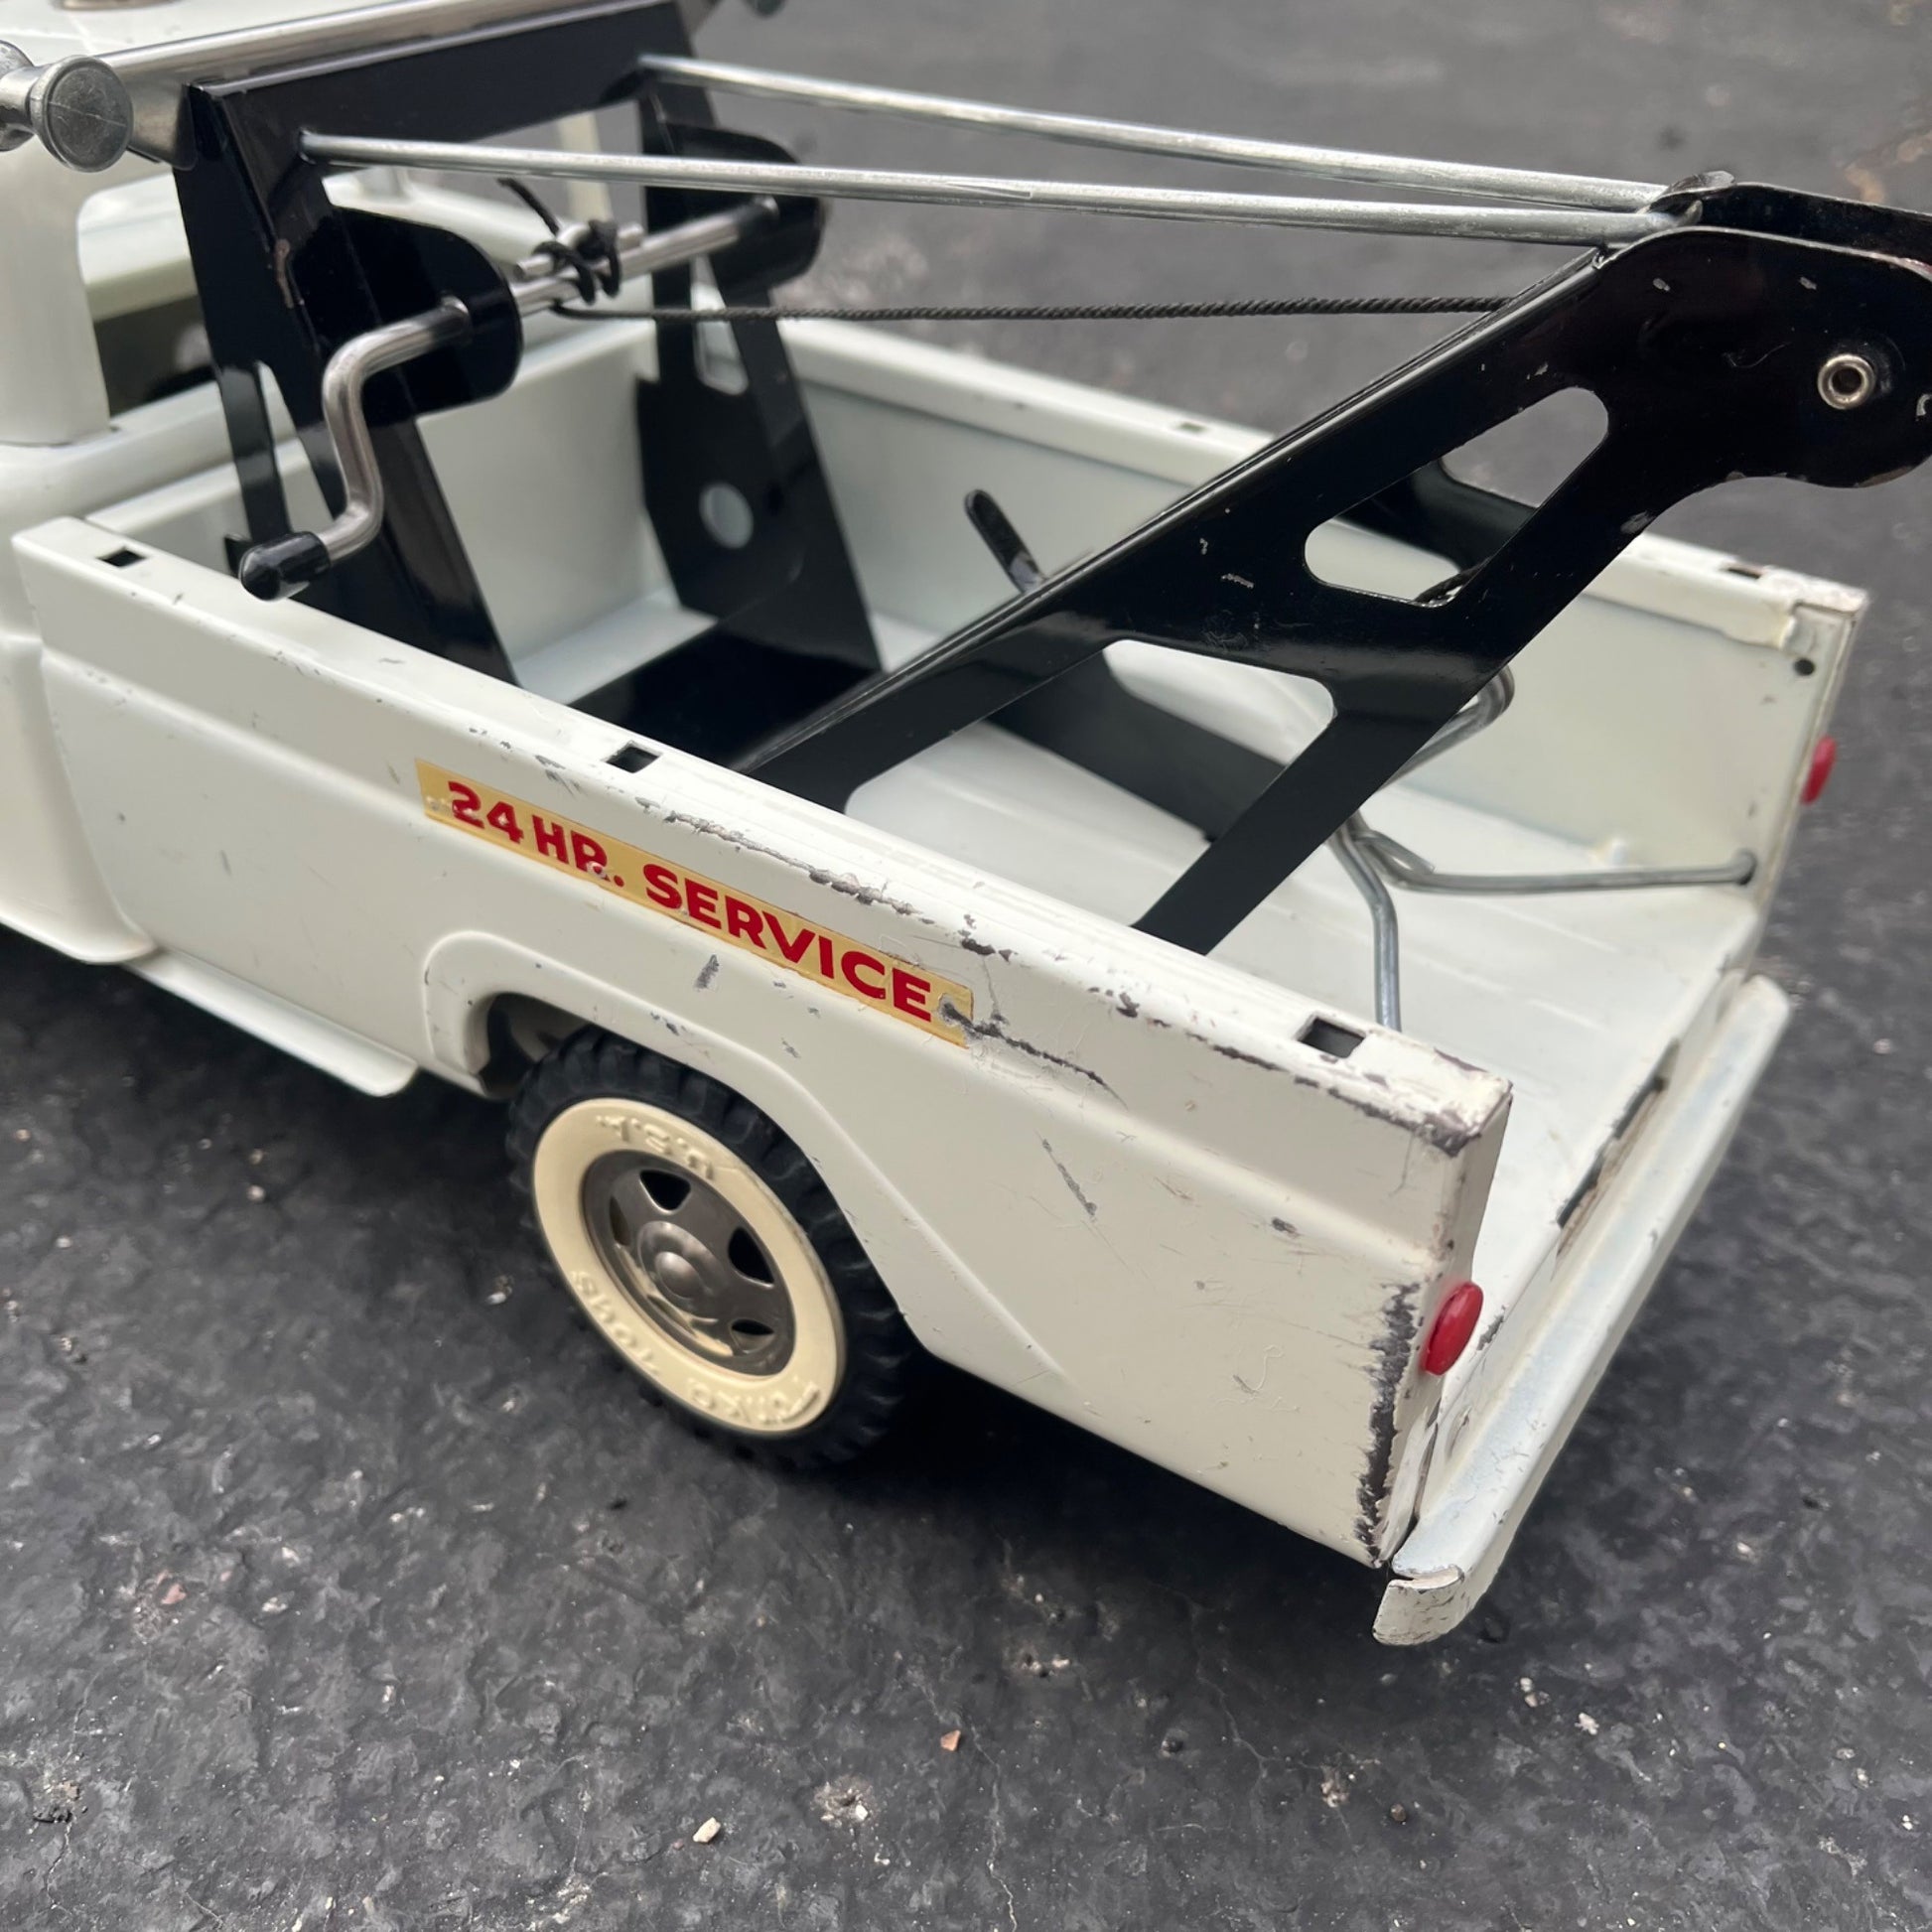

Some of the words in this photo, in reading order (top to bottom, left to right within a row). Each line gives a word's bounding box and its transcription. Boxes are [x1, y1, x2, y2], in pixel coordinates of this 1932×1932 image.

[448, 780, 524, 845] 24
[532, 814, 624, 888] HR.
[642, 863, 932, 1023] SERVICE
